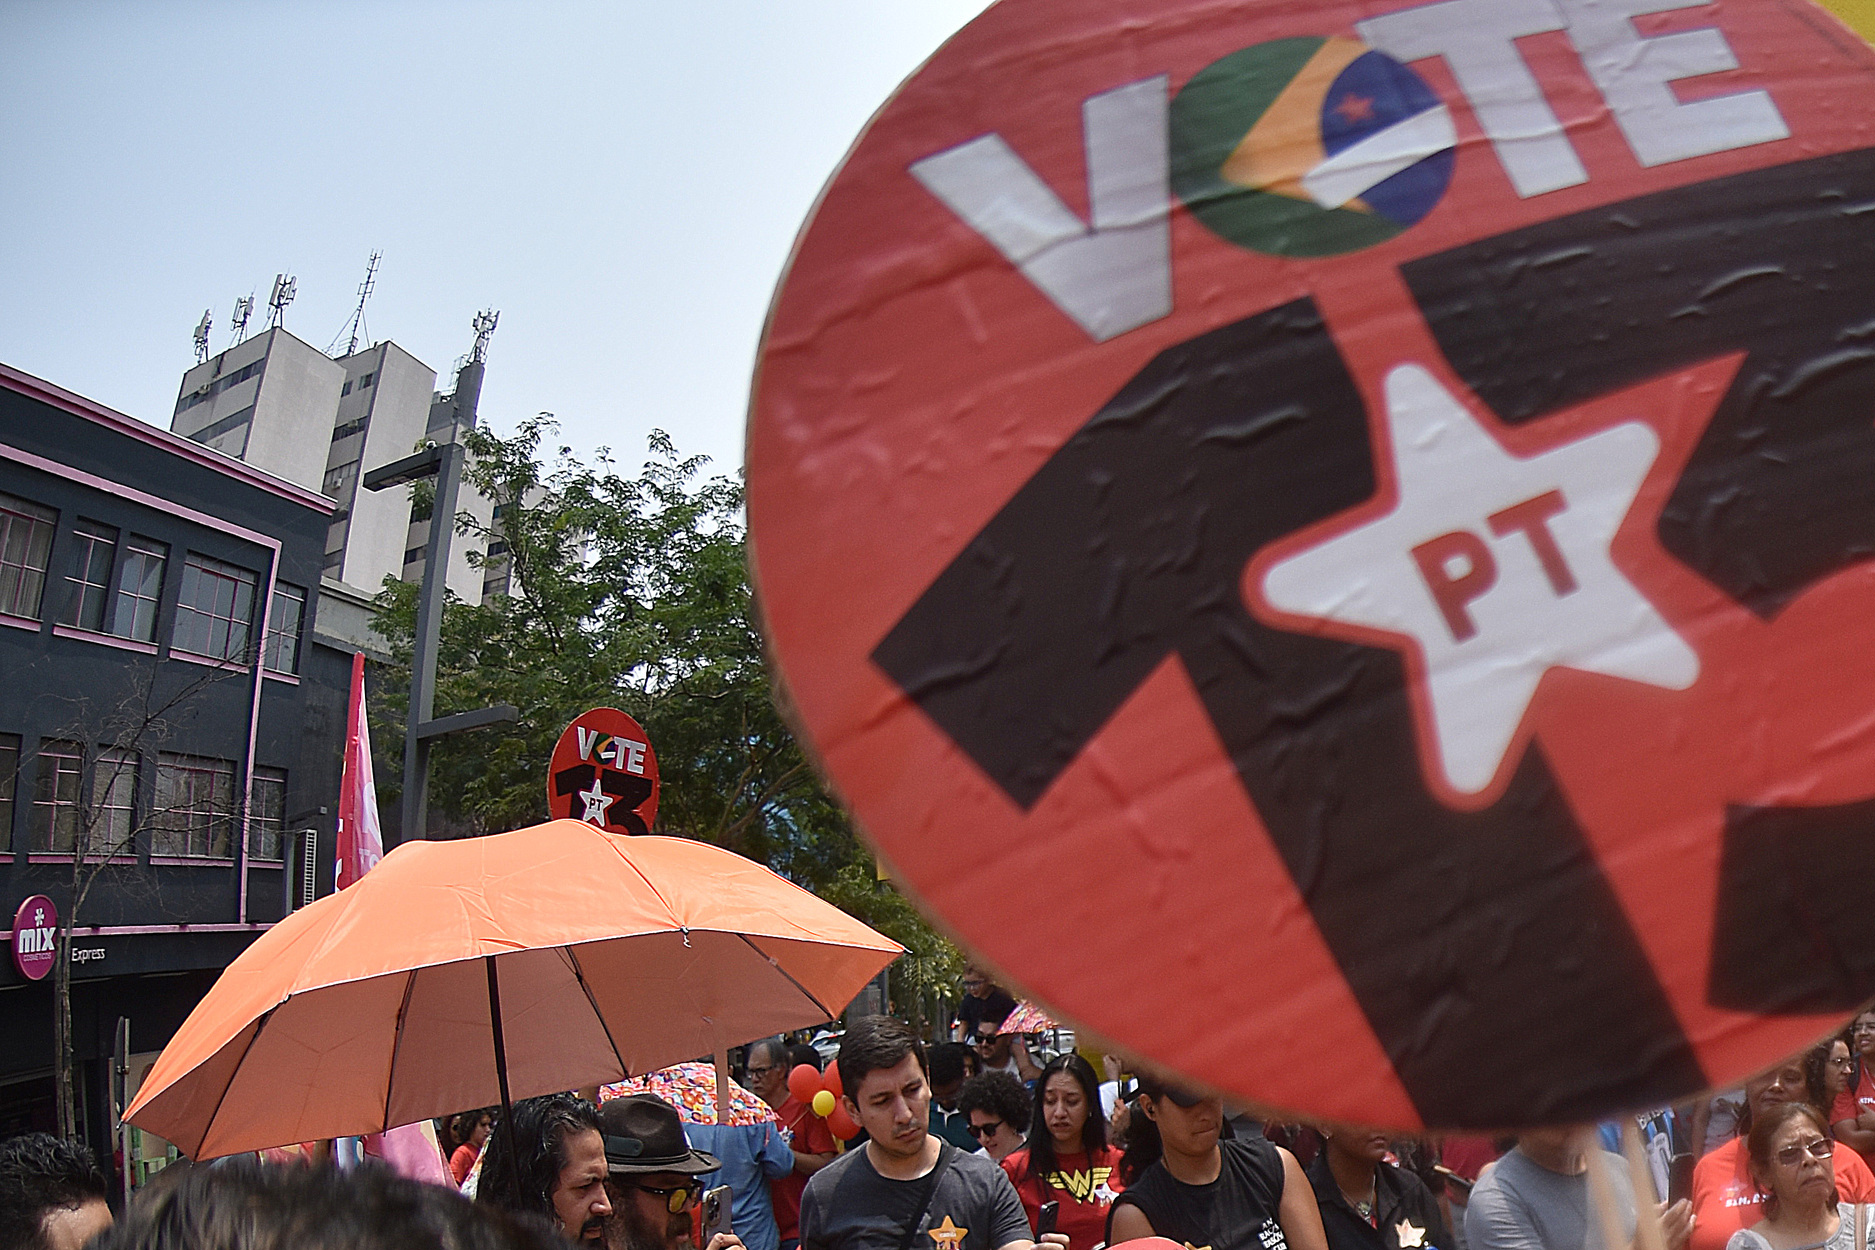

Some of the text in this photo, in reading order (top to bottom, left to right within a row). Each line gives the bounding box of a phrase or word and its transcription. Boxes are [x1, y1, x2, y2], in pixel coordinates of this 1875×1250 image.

[908, 0, 1790, 344] VOTE
[1409, 488, 1580, 644] PT
[577, 726, 647, 775] VOTE
[555, 764, 653, 835] 13
[588, 797, 602, 812] PT
[71, 947, 105, 964] Express
